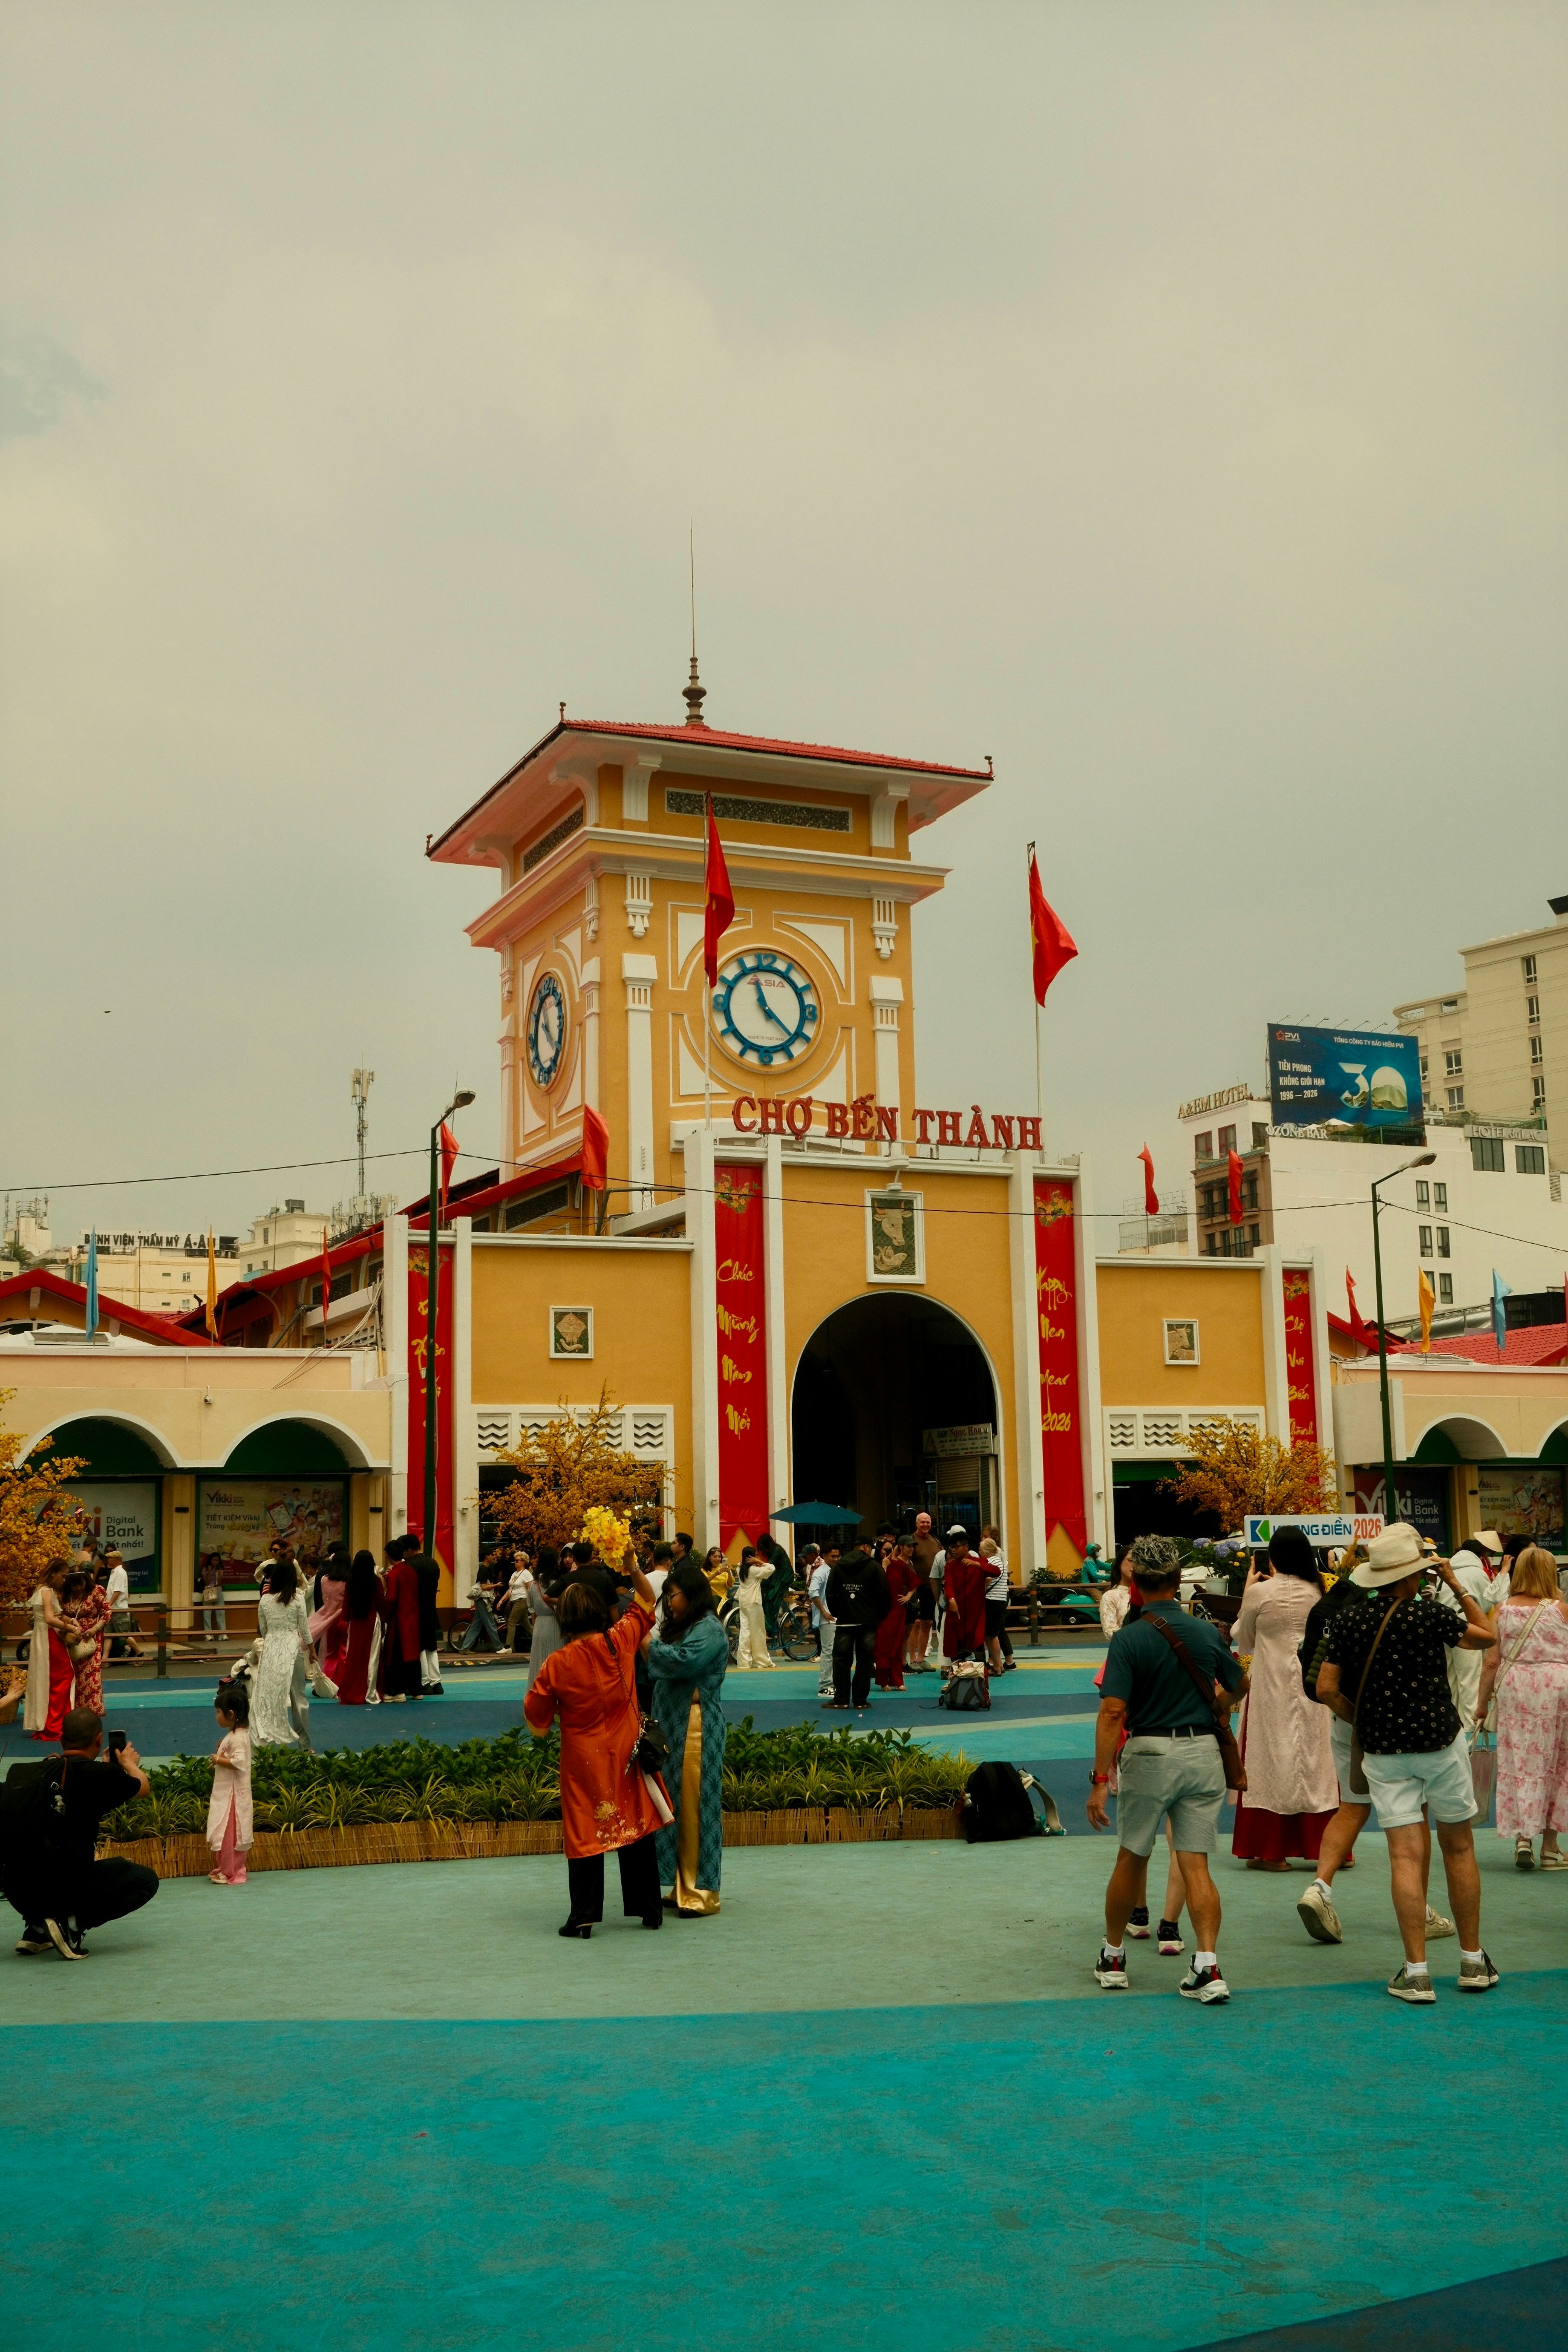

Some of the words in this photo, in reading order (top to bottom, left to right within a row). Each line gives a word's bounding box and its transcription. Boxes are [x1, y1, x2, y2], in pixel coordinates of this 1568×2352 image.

[756, 953, 779, 970] 12
[713, 993, 728, 1012] 9
[803, 1004, 817, 1022] 3
[759, 1047, 773, 1065] 6
[1278, 1059, 1290, 1071] TIÊN
[1292, 1063, 1312, 1073] PHONG
[1279, 1074, 1299, 1086] KHÔNG
[1300, 1077, 1312, 1085] GIỚI
[1313, 1078, 1325, 1087] HẠN
[1213, 1083, 1250, 1109] HOTEL
[1280, 1091, 1293, 1100] 1996
[1304, 1089, 1318, 1098] 2026
[733, 1096, 813, 1141] CHỢ
[826, 1093, 898, 1142] BẾN
[912, 1105, 1044, 1151] THÀNH
[1266, 1125, 1305, 1137] OZONE
[1306, 1128, 1328, 1138] BAR
[1472, 1126, 1507, 1138] HOTEL
[1509, 1129, 1520, 1139] du
[1521, 1129, 1541, 1140] LAC
[85, 1234, 110, 1245] BNH
[114, 1233, 134, 1246] VIỆN
[137, 1233, 163, 1246] THẨM
[166, 1235, 180, 1247] MỸ
[717, 1259, 755, 1281] Chúc
[1036, 1265, 1073, 1310] Happy
[716, 1304, 760, 1343] Mừng
[1287, 1347, 1304, 1368] Vui
[722, 1354, 752, 1387] Năm
[1042, 1412, 1071, 1431] 2026
[968, 1426, 981, 1436] Hoa
[206, 1489, 232, 1503] Vikki
[1415, 1505, 1439, 1515] Bank
[106, 1517, 136, 1525] Digital
[1321, 1517, 1352, 1535] ĐIỀN
[1354, 1518, 1382, 1540] 2026
[106, 1524, 144, 1537] Bank
[122, 1539, 144, 1548] nhất!
